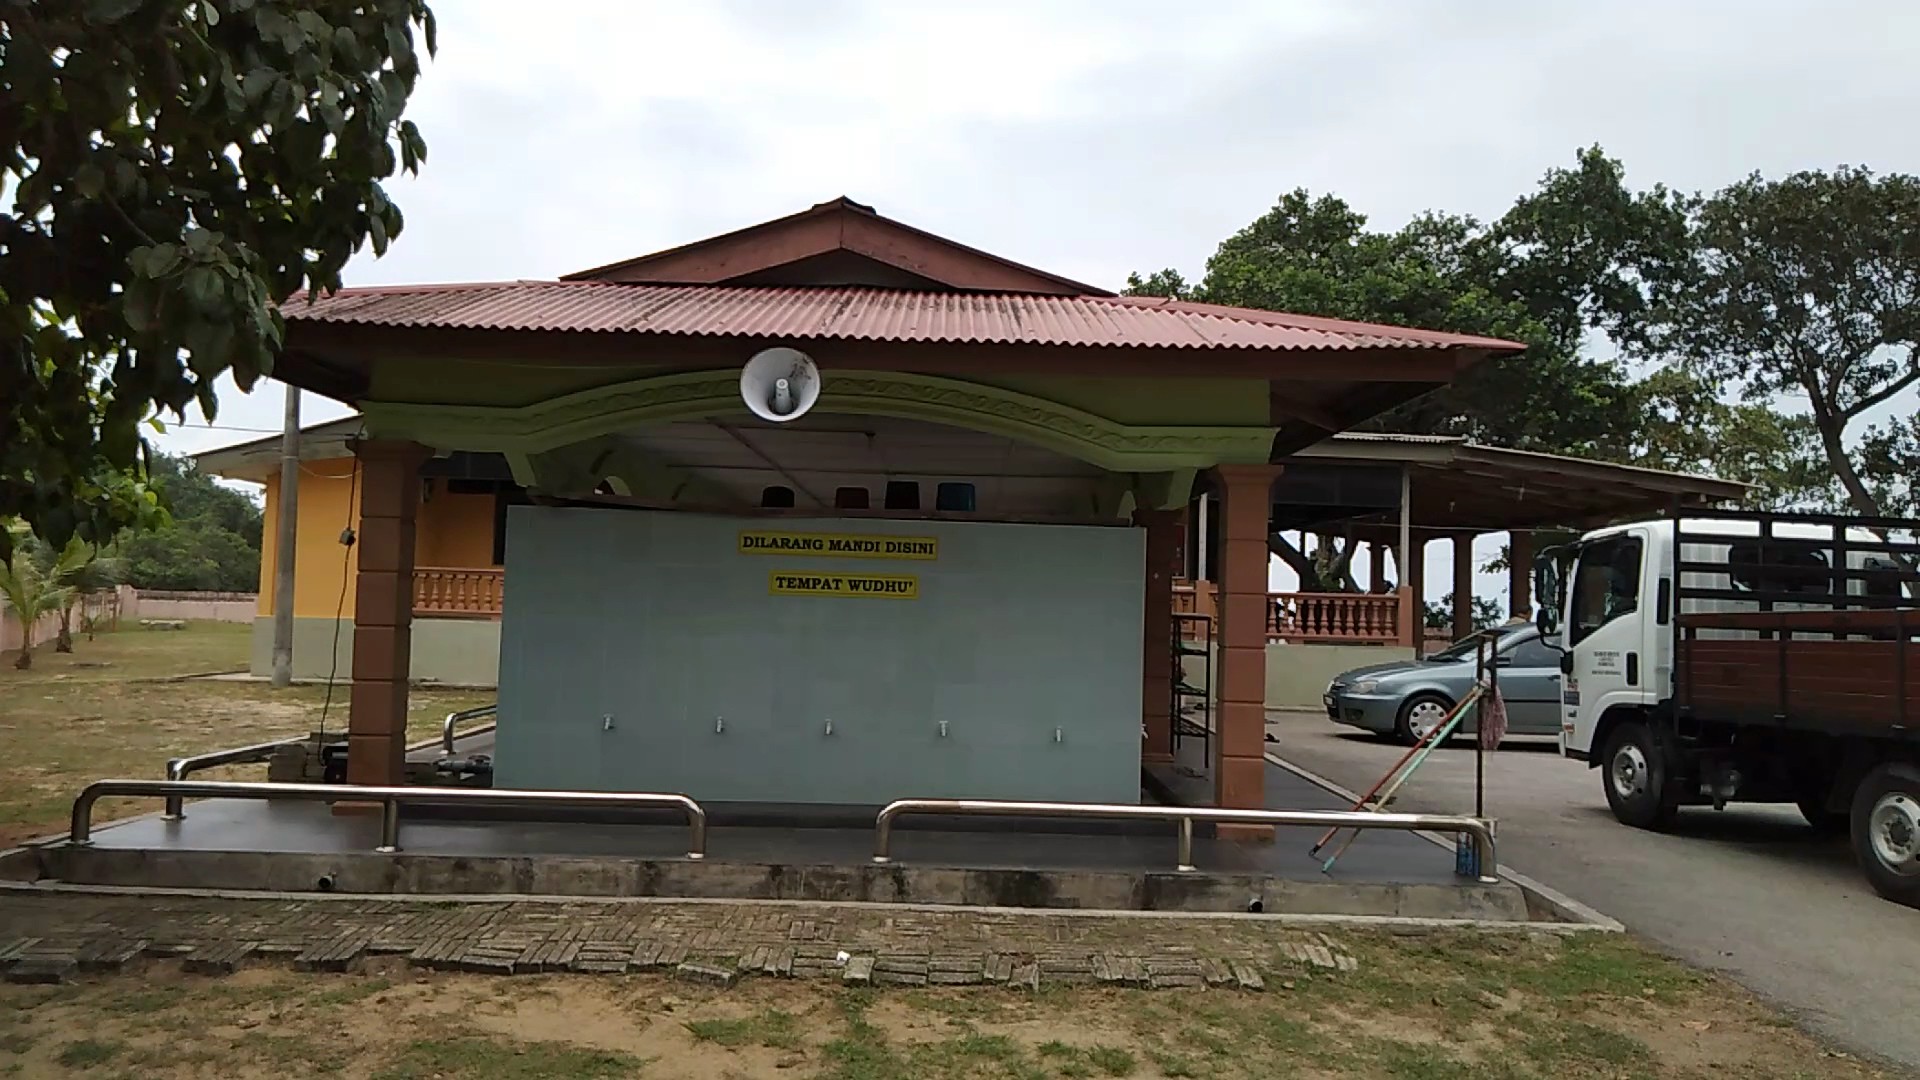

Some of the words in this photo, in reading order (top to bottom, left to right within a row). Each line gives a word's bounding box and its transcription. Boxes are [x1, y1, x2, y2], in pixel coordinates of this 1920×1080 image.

[743, 536, 824, 551] DILARANG
[829, 540, 880, 552] MANDI
[885, 541, 934, 555] DISINI
[775, 576, 843, 590] TEMPAT
[848, 579, 913, 593] WUDHU'
